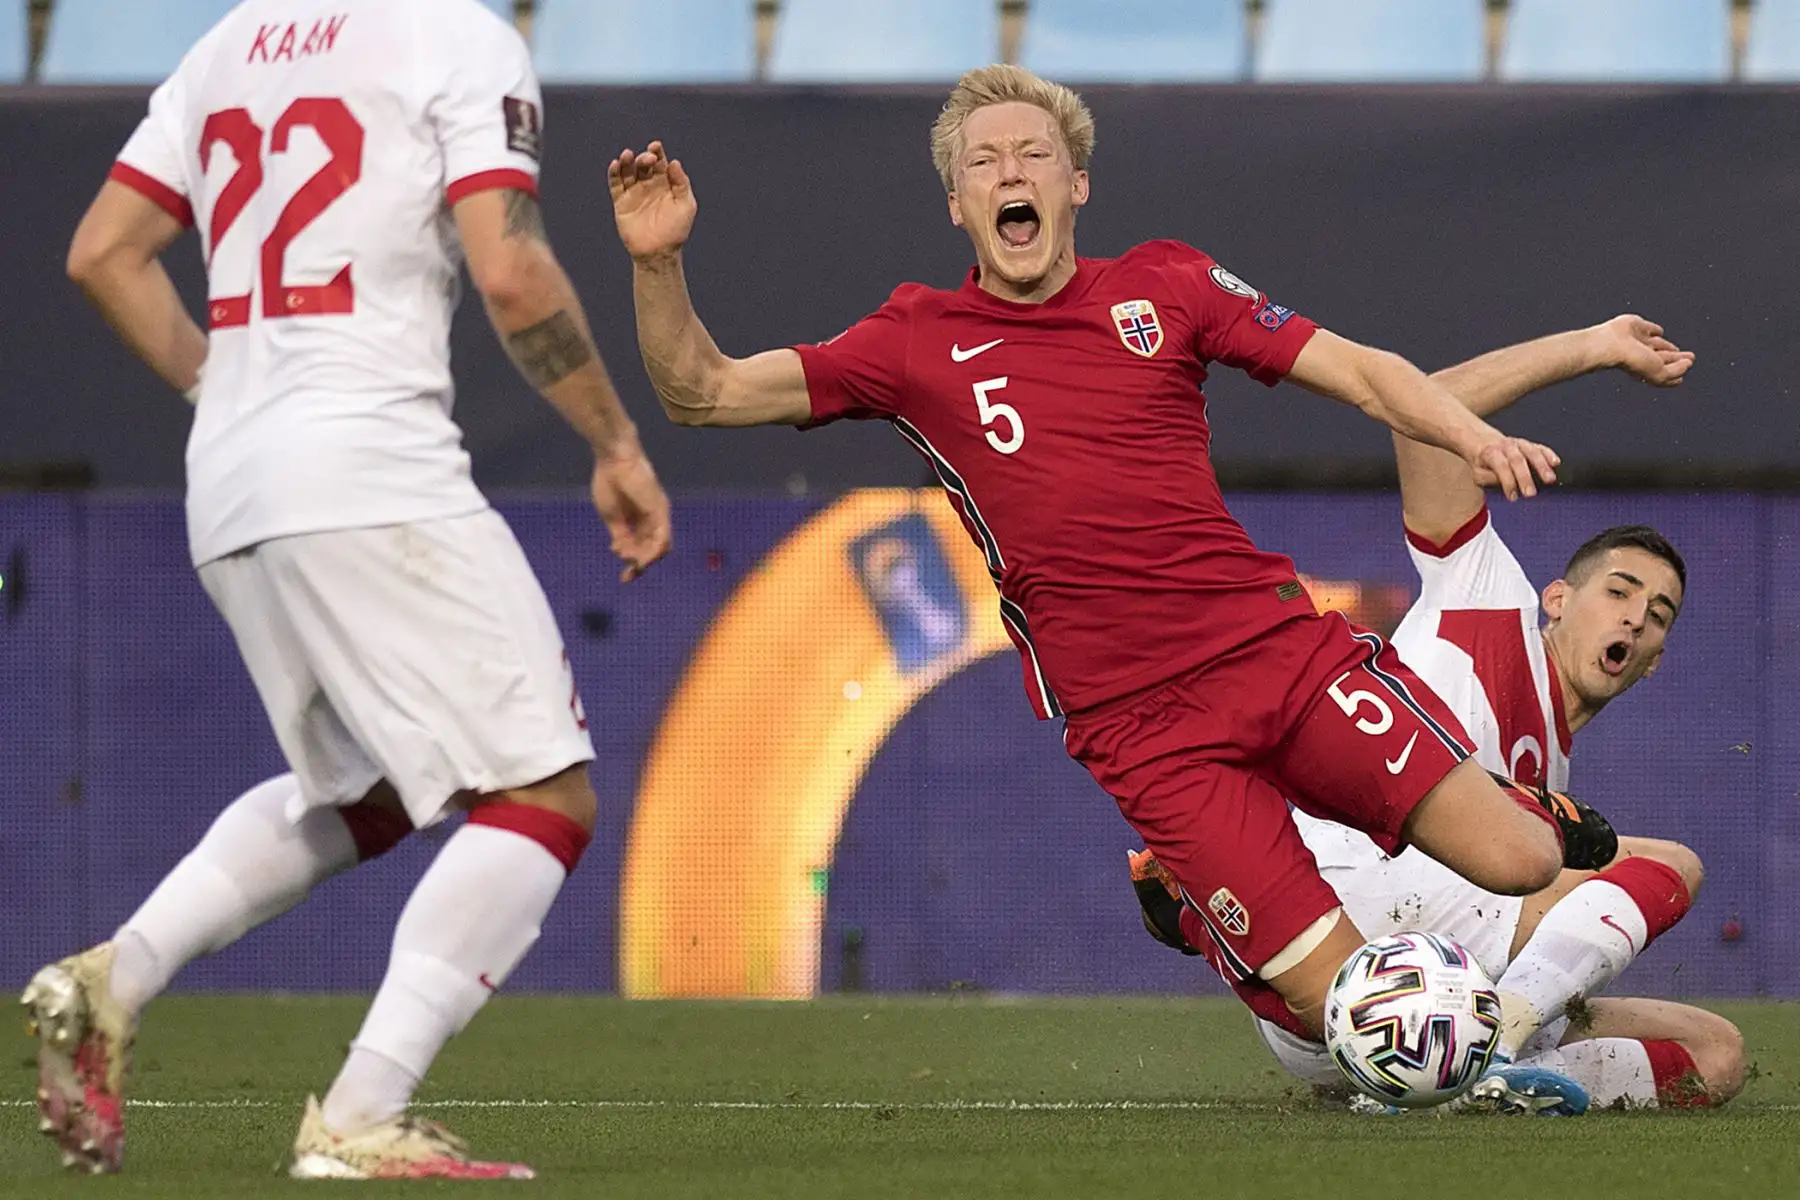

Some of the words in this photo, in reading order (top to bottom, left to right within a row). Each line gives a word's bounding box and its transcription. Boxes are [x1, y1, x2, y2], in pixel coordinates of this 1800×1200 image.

[247, 13, 348, 64] KAAN
[198, 96, 365, 331] 22
[972, 376, 1025, 454] 5
[1326, 671, 1395, 736] 5
